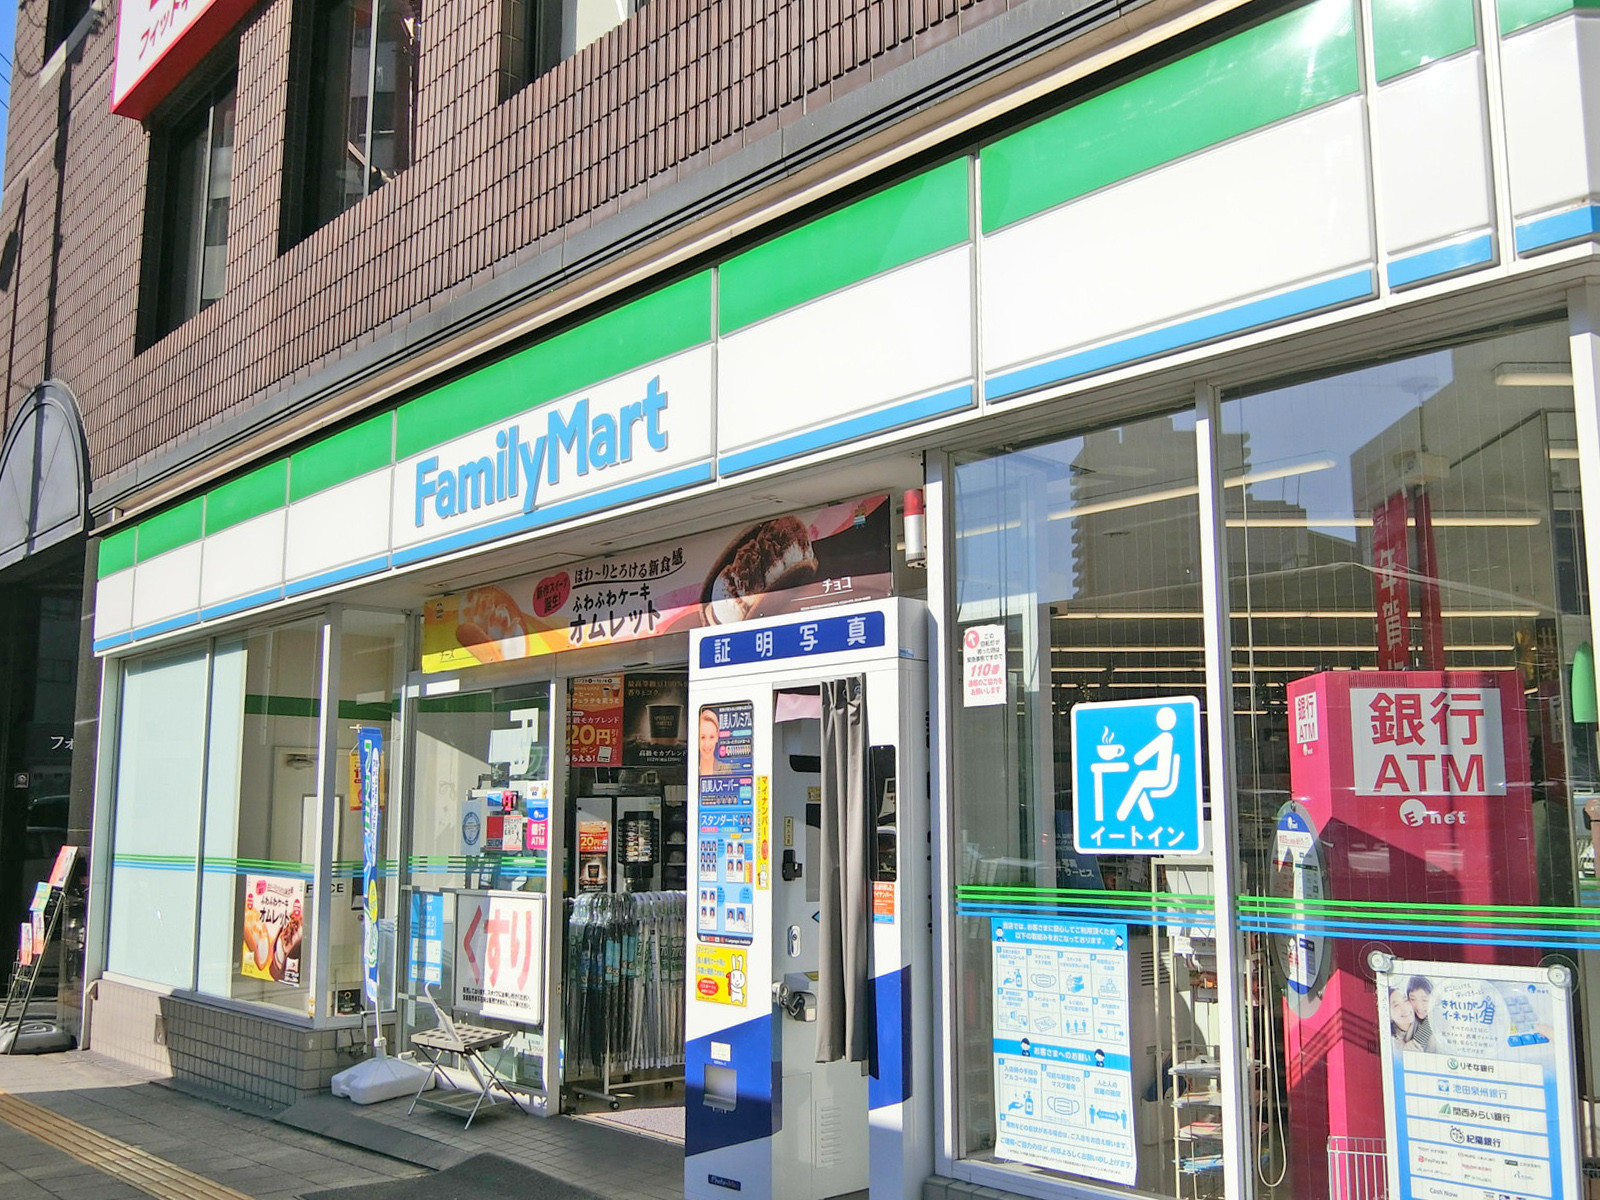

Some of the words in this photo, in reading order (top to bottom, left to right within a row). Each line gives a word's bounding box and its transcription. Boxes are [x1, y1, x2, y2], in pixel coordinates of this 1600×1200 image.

[415, 375, 668, 527] FamilyMart
[821, 576, 852, 594] チョコ
[572, 583, 651, 612] ふわふわケーキ
[1379, 549, 1405, 671] 年賀
[569, 600, 662, 644] オムレット
[1297, 696, 1314, 721] 銀行
[1369, 692, 1485, 747] 銀行
[1299, 723, 1316, 741] ATM
[1373, 754, 1485, 792] ATM
[761, 776, 769, 837] マイナンバー
[701, 814, 739, 826] スタンダード
[530, 836, 545, 846] ATM
[1090, 825, 1185, 847] イートイン
[260, 907, 290, 926] オムレット
[463, 905, 532, 992] くすり
[1441, 999, 1478, 1011] きれいが
[1442, 1011, 1480, 1024] イーネット!
[1034, 1046, 1092, 1062] お客さまへのお願い
[1460, 1062, 1494, 1074] りそな銀行
[1097, 1079, 1118, 1089] 人と人の
[1453, 1083, 1508, 1100] 池田泉州銀行
[1453, 1106, 1510, 1123] 関西みらい銀行
[1466, 1134, 1501, 1148] 紀陽銀行
[1429, 1187, 1443, 1195] Cash
[1444, 1190, 1458, 1198] Now
